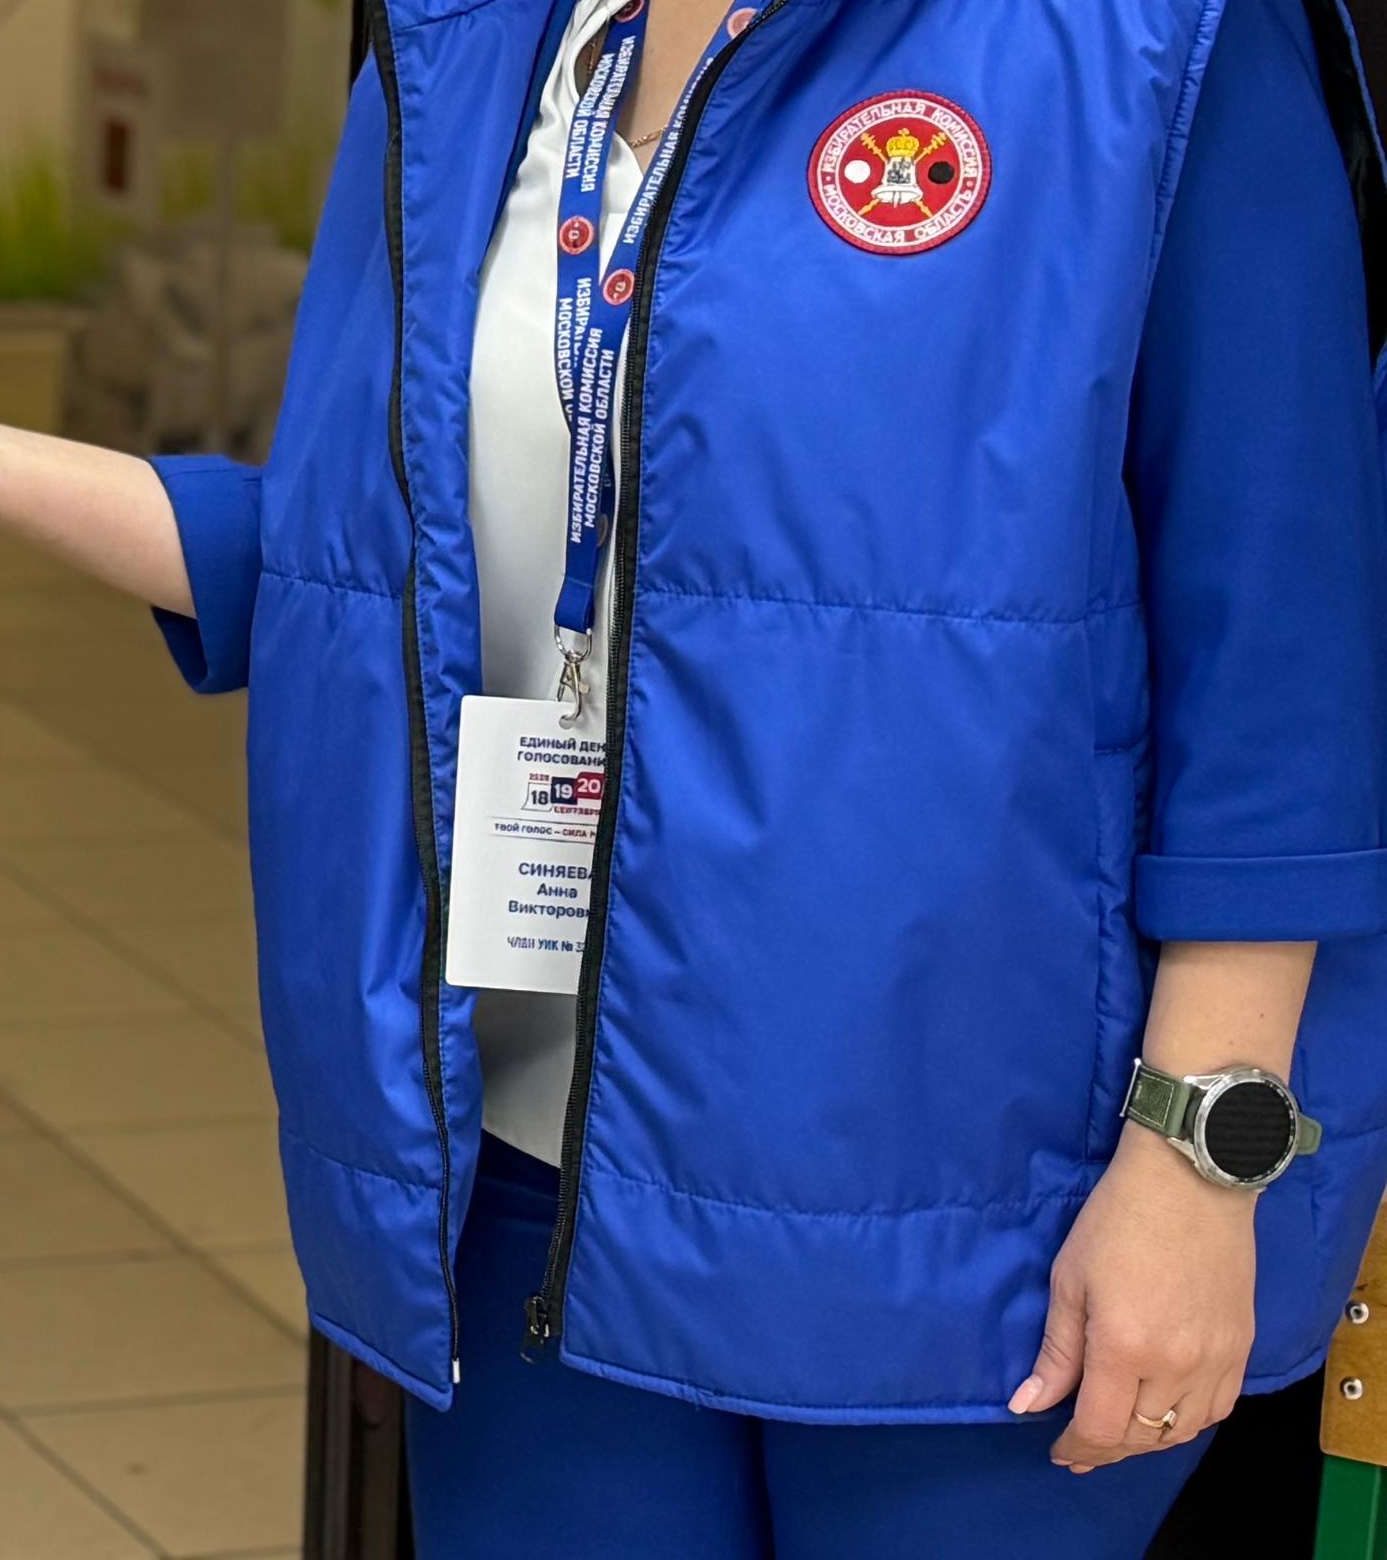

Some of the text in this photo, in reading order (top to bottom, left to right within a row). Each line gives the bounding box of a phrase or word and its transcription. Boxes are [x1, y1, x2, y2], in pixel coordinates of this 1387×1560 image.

[821, 100, 978, 178] ИЗБИРАТЕЛЬНАЯ КОМИССИЯ
[823, 184, 974, 244] МОСКОВСКАЯ ОБЛАСТЬ
[578, 328, 603, 416] КОМИССИЯ
[584, 349, 615, 528] МОСКОВСКОЙ ОБЛАСТИ
[570, 418, 592, 544] ИЗБИРАТЕЛЬНАЯ
[520, 736, 576, 750] ЕДИНЫЙ
[531, 778, 601, 805] 18 19 20
[537, 883, 578, 898] Анна
